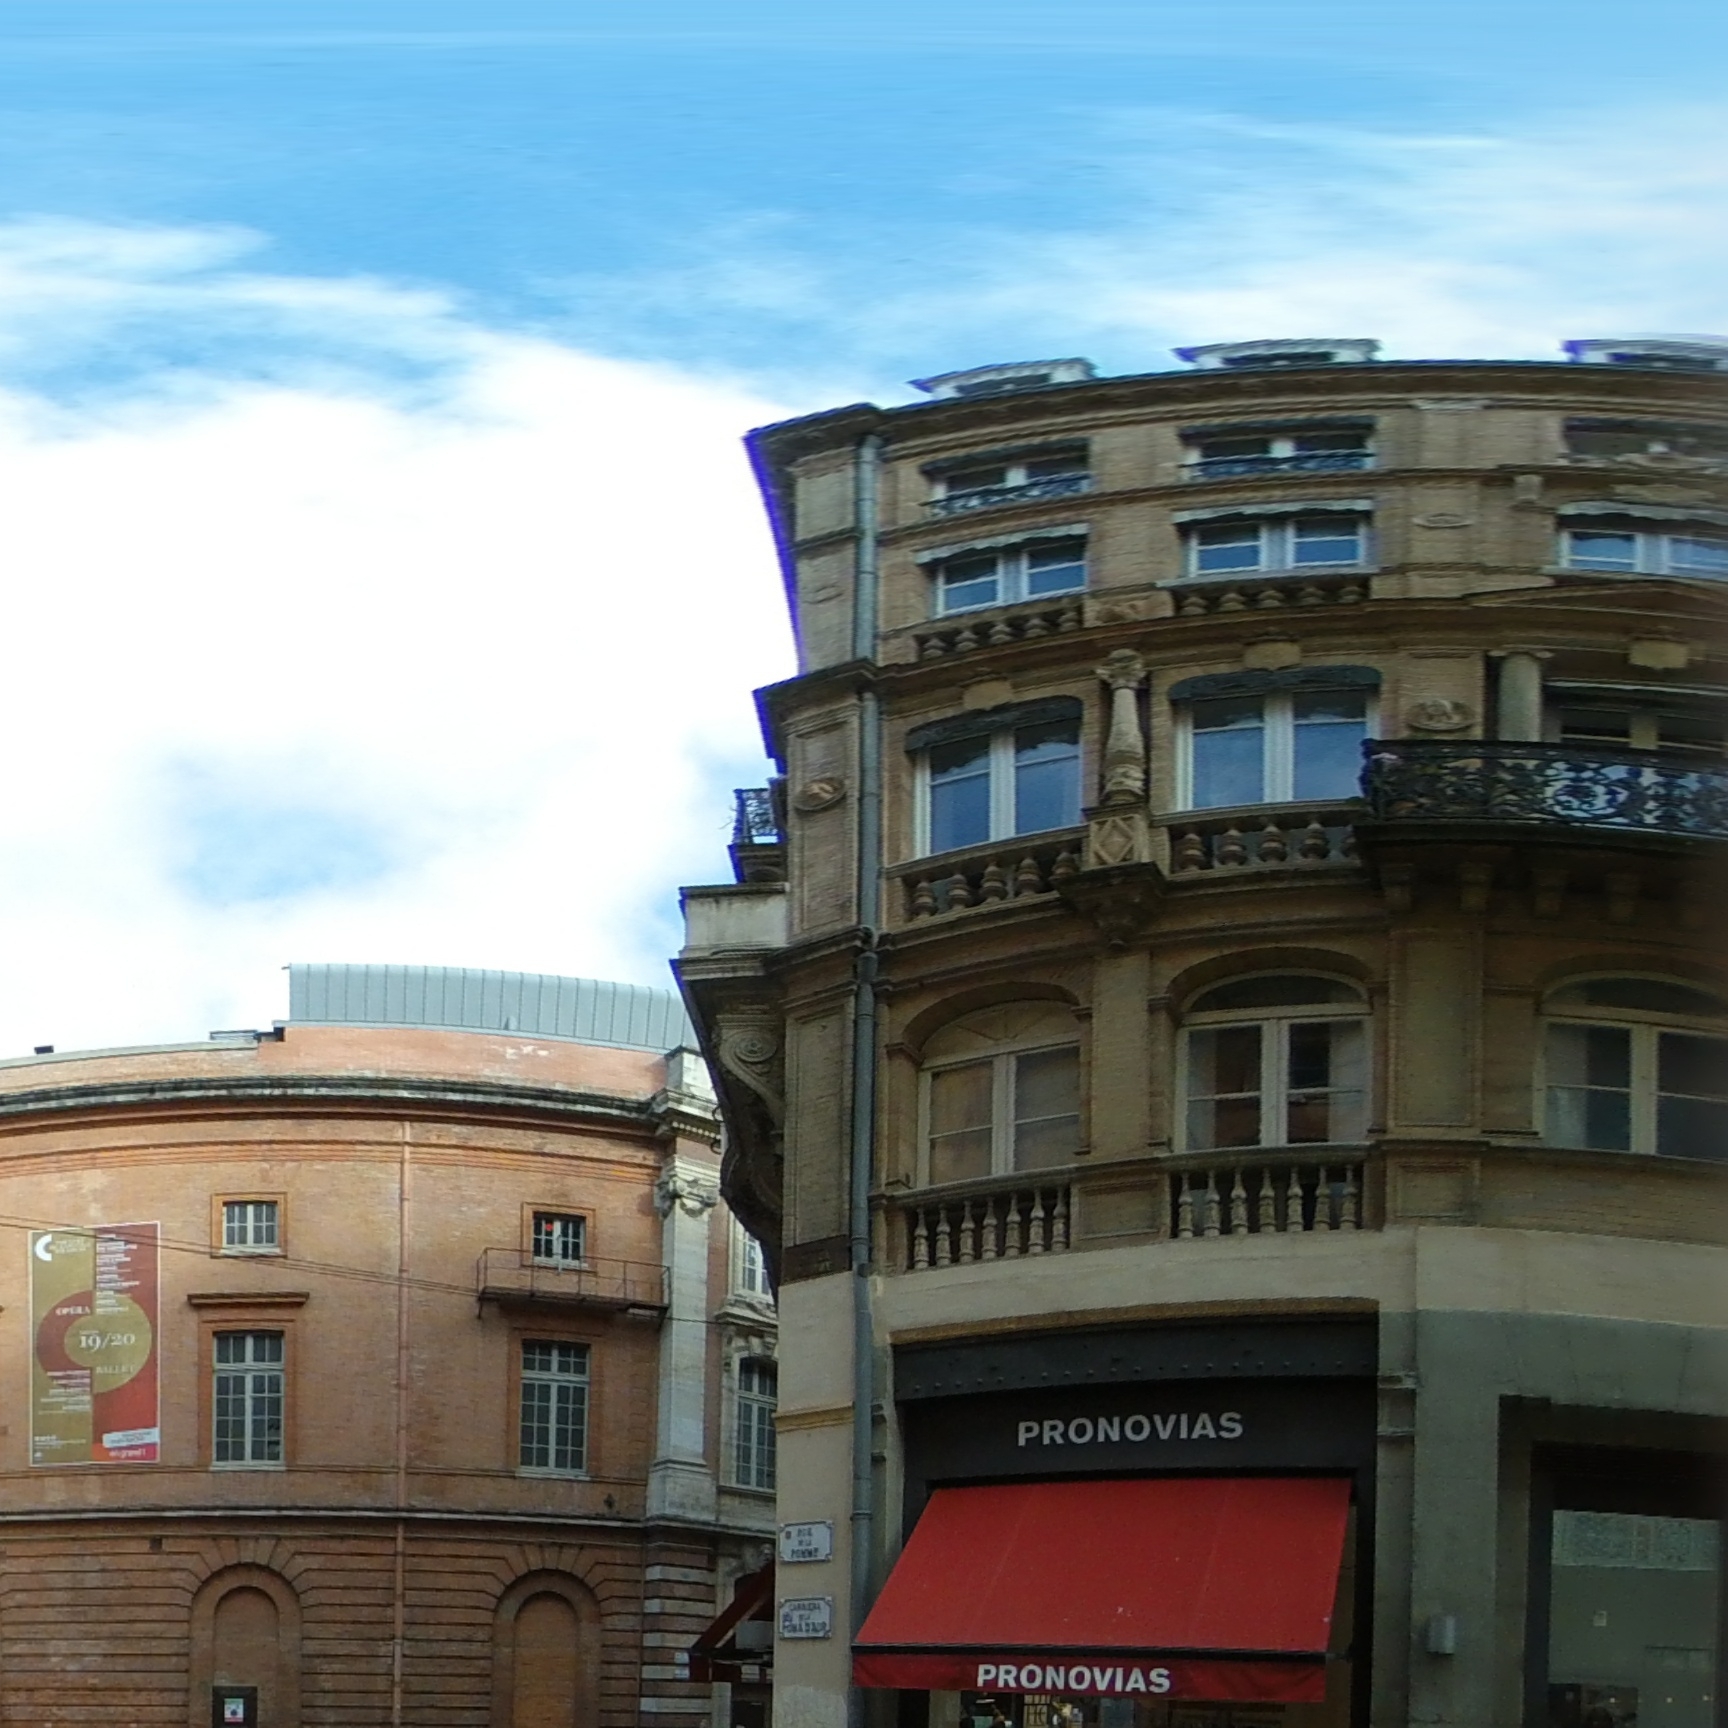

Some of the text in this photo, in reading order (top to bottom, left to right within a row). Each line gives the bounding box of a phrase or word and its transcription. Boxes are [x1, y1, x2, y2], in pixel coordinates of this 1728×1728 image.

[79, 1332, 136, 1352] 19/20
[1017, 1411, 1244, 1447] PRONOVIAS
[977, 1664, 1171, 1693] PRONOVIAS
